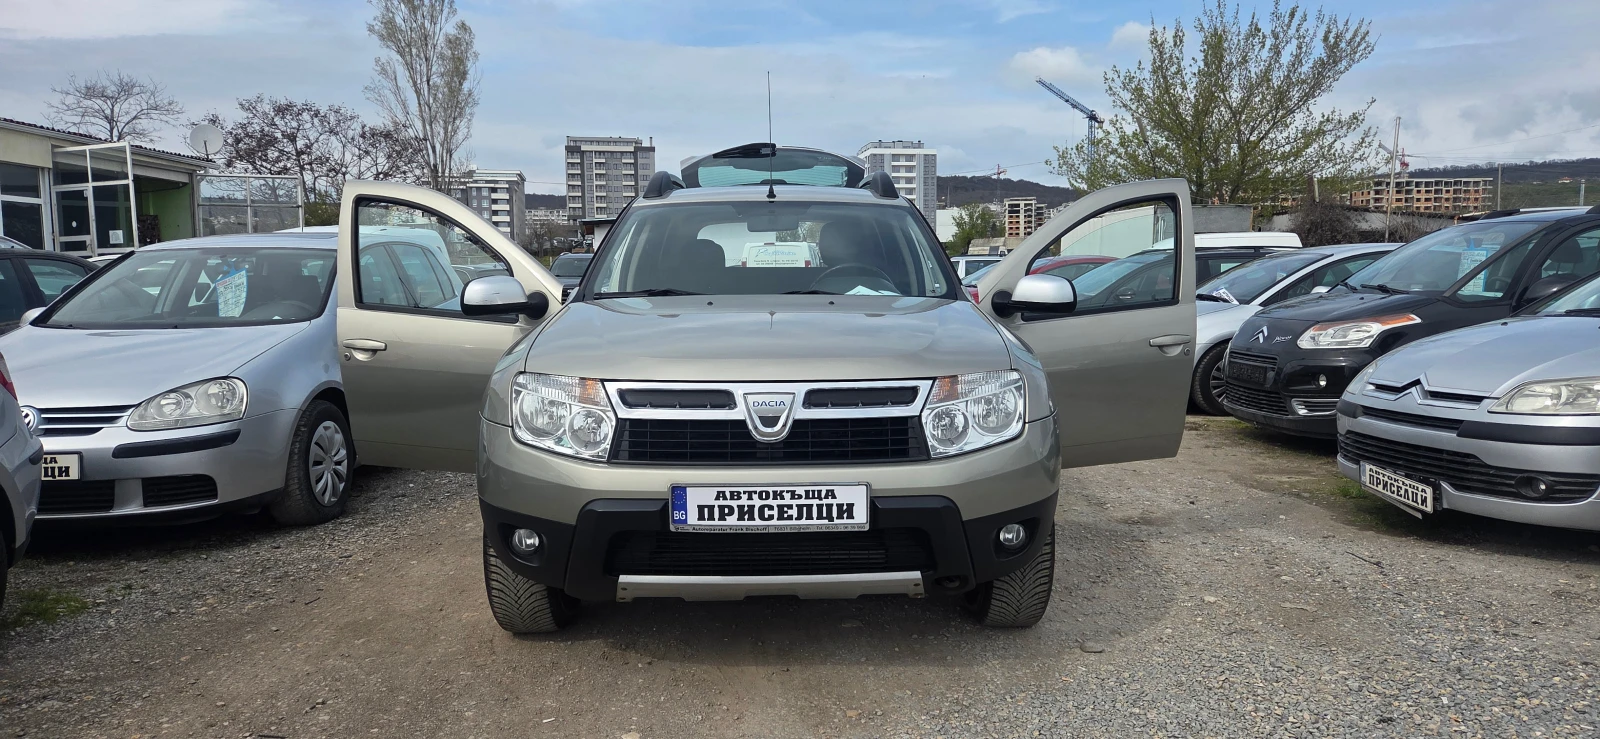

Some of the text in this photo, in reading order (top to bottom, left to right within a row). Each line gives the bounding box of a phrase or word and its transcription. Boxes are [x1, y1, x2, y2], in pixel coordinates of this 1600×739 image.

[1368, 467, 1428, 494] АВТОКЪЩА
[714, 489, 837, 501] АВТОКЪЩА
[1368, 473, 1428, 508] ПРИСЕЛЦИ
[673, 511, 686, 520] BG
[696, 503, 855, 522] ПРИСЕЛЦИ
